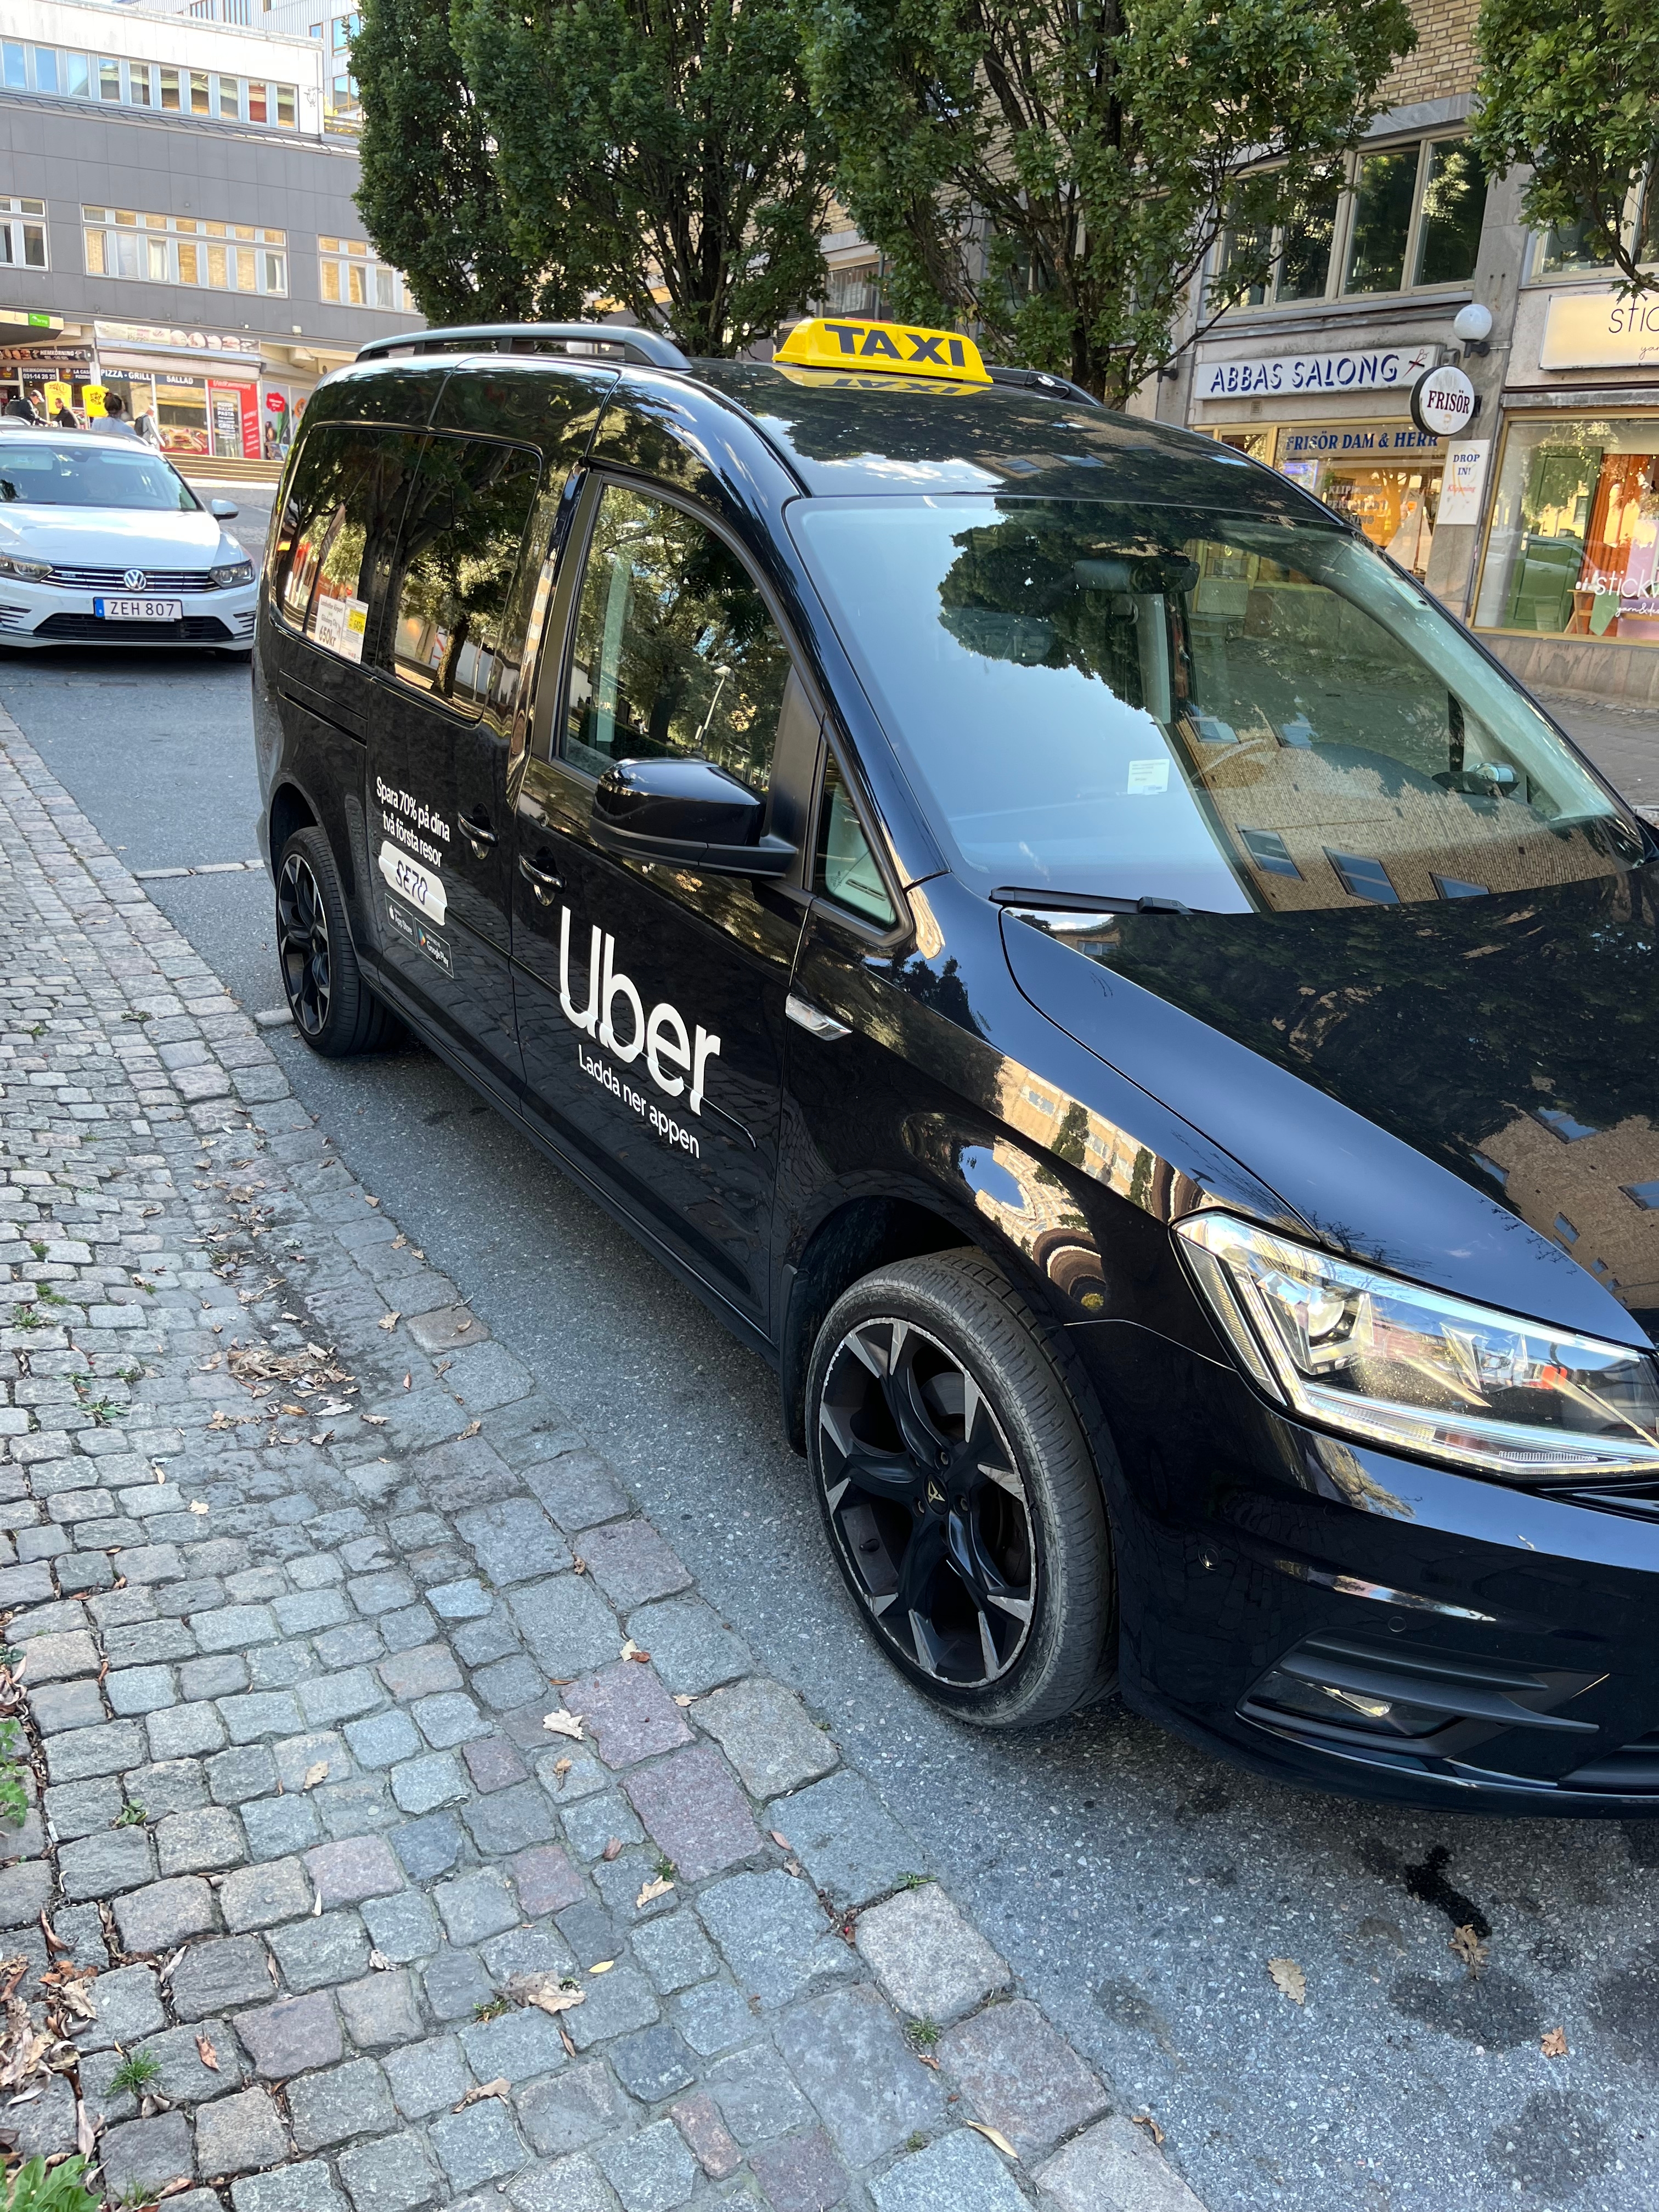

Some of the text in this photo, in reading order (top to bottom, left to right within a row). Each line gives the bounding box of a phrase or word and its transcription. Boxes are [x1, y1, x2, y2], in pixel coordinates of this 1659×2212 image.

[825, 324, 965, 368] TAXI
[101, 369, 123, 378] PIZZA
[128, 372, 151, 381] GRILL
[166, 375, 194, 385] SALLAD
[1210, 354, 1400, 393] ABBAS SALONG
[1427, 390, 1470, 414] FRISÖR
[1285, 431, 1438, 450] FRISÖR DAM & HERR
[1447, 484, 1476, 493] Klippning
[110, 601, 174, 617] ZEH 807
[319, 625, 336, 647] 650kr
[377, 776, 450, 842] Spara 70% på dina
[383, 810, 442, 867] två första resor
[403, 919, 413, 935] Store
[427, 940, 449, 968] Google Play
[560, 905, 720, 1116] Uber
[579, 1044, 699, 1159] Ladda ner appen
